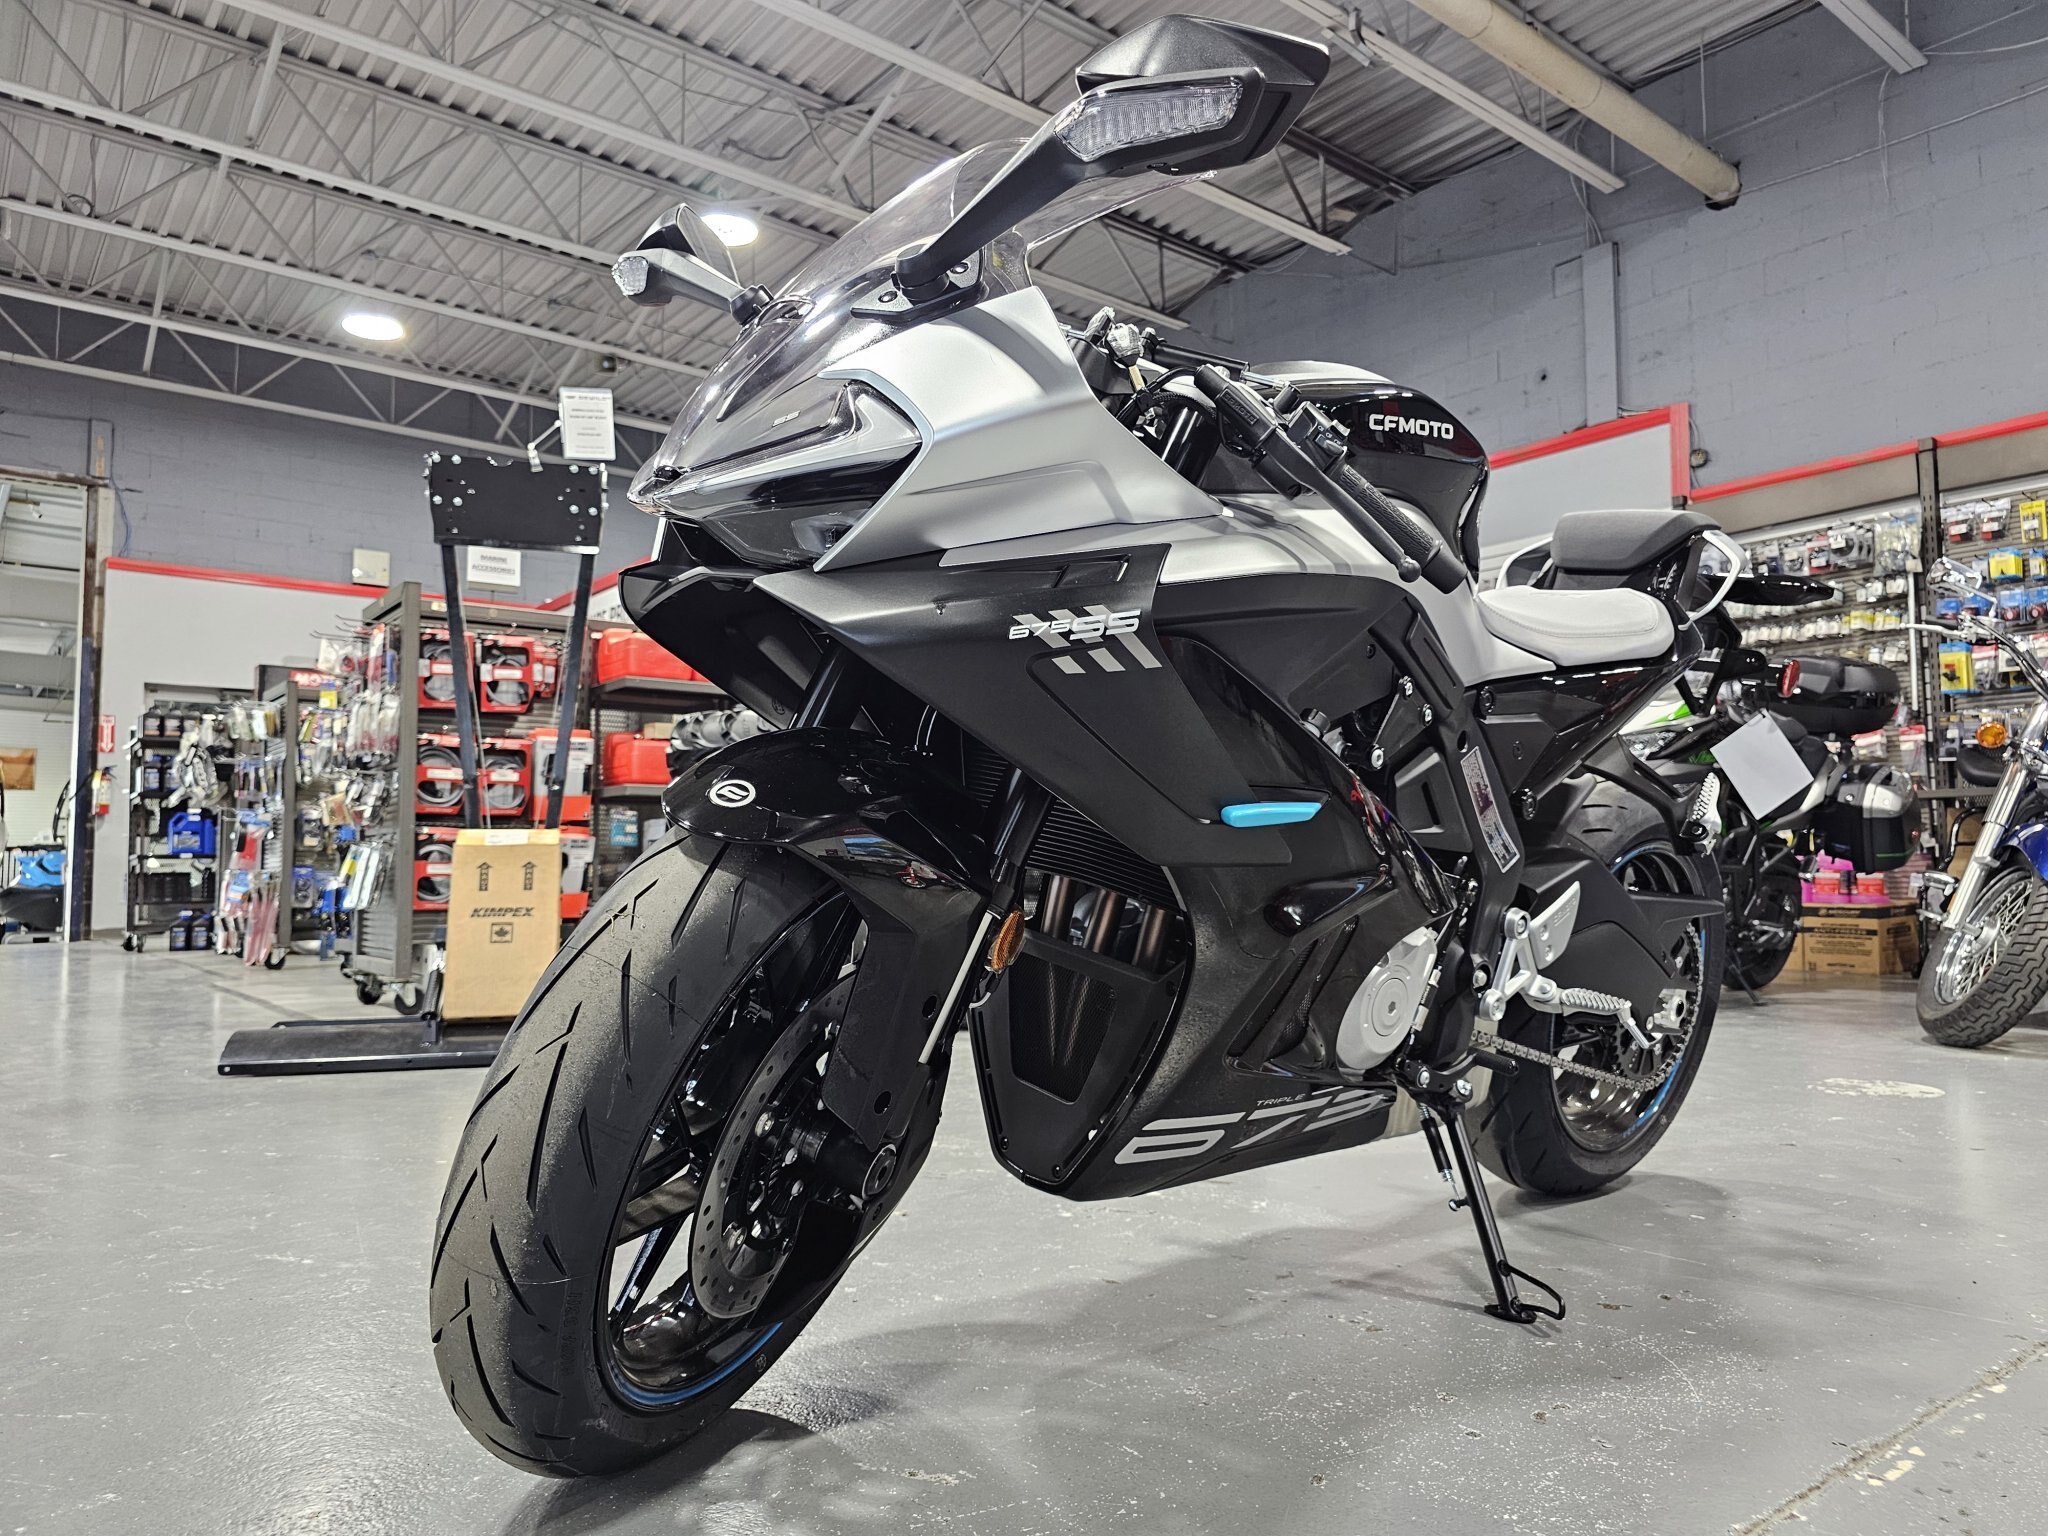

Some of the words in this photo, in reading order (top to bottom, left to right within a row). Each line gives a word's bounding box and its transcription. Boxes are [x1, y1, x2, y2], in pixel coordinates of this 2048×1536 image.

[1369, 413, 1454, 440] CFMOTO
[470, 906, 535, 918] KIMPEX
[1256, 1093, 1306, 1107] TRIPLE
[1114, 1086, 1384, 1165] 675
